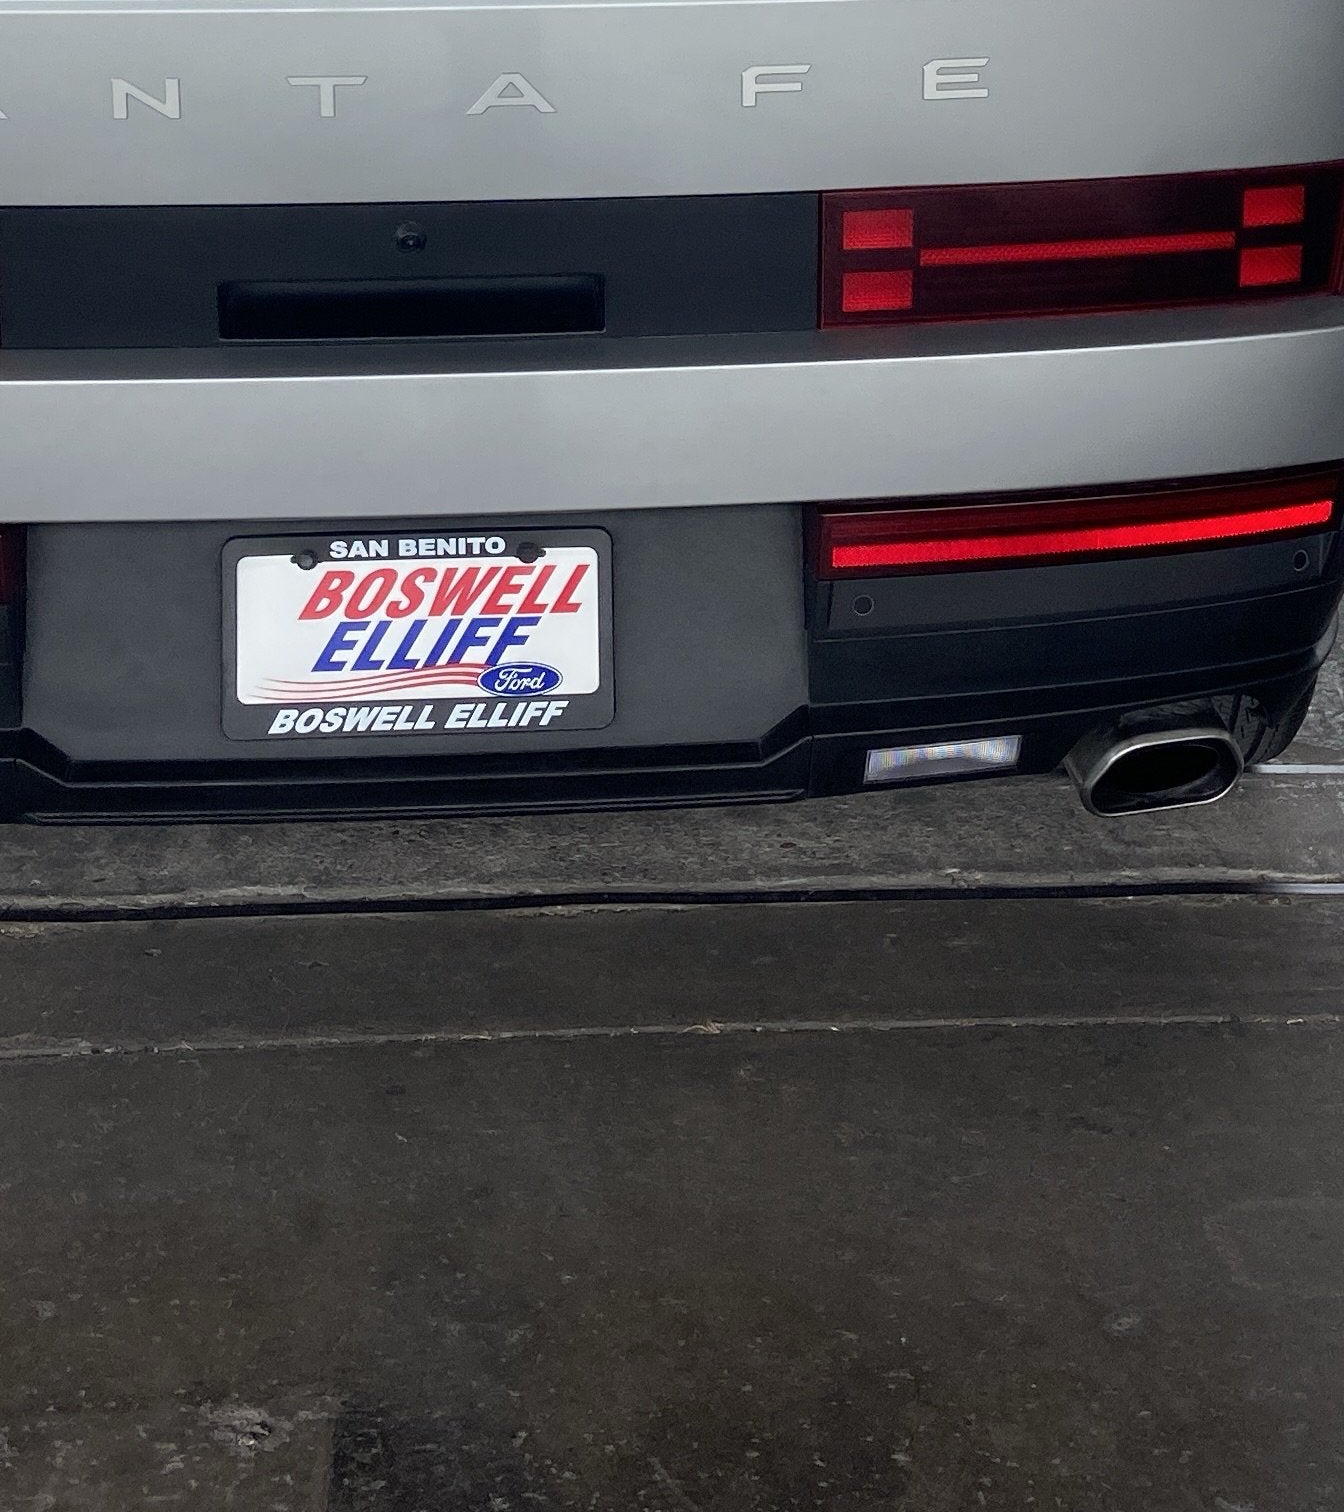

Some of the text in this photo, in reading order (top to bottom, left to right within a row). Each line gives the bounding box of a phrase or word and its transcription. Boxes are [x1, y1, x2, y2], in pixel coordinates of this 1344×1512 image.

[740, 56, 991, 108] FE
[328, 536, 507, 559] SAN BENITO
[297, 563, 591, 621] BOSWELL
[311, 616, 543, 673] ELLIFF
[492, 667, 547, 693] Ford
[267, 700, 570, 735] BOSWELL ELLIFF
